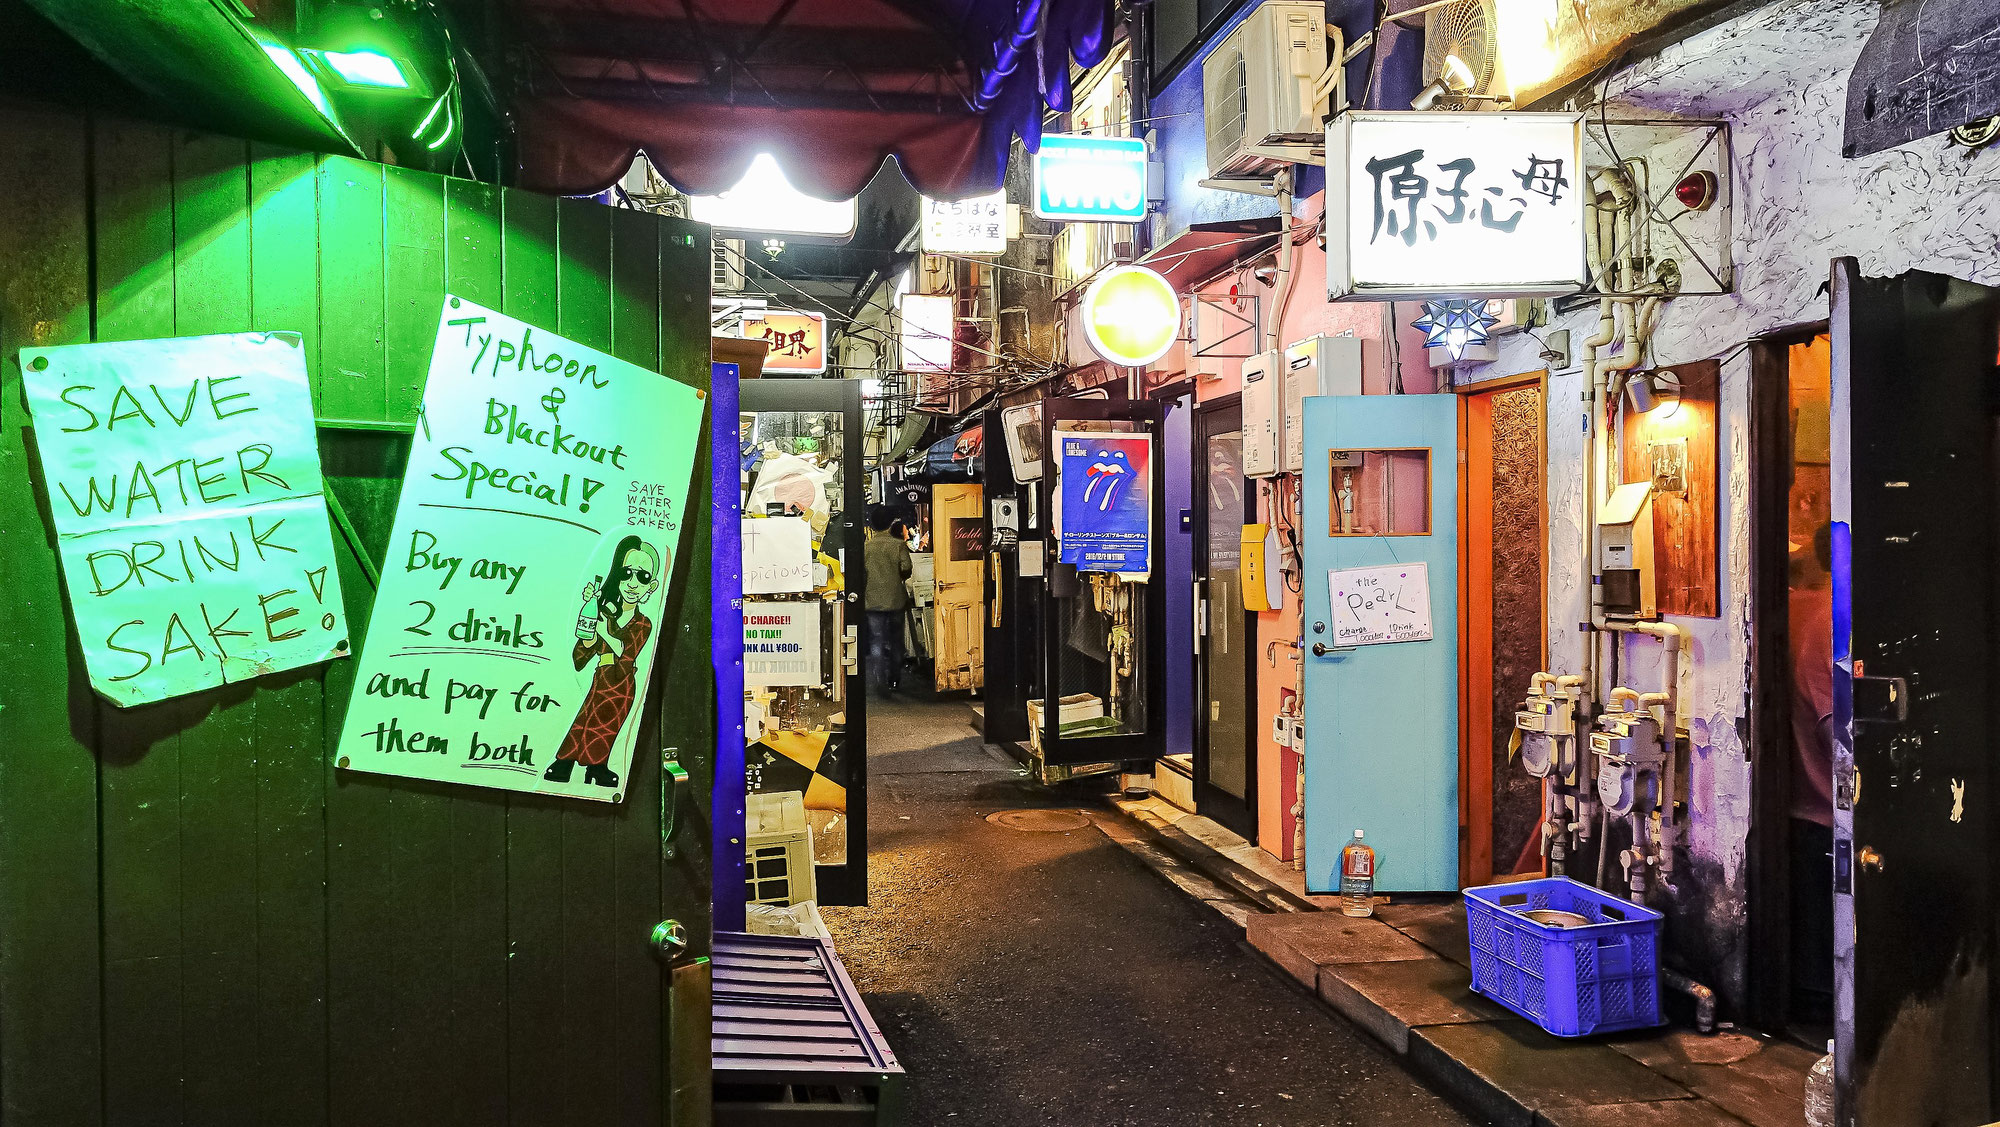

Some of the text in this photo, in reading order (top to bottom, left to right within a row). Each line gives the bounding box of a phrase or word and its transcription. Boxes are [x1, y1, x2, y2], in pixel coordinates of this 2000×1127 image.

[1365, 149, 1569, 247] 原子心母
[448, 317, 609, 389] Typhoon
[60, 376, 259, 433] SAVE
[541, 387, 566, 423] &
[484, 397, 628, 471] Blackout
[59, 443, 291, 518] WATER
[431, 447, 604, 513] Special!
[627, 494, 671, 509] WATER
[629, 481, 665, 496] SAVE
[628, 505, 670, 520] DRINK
[86, 516, 298, 596] DRINK
[405, 529, 526, 594] Buy any
[1356, 577, 1377, 587] the
[106, 566, 335, 681] SAKE!
[404, 600, 544, 648] 2 drinks
[746, 629, 782, 639] NO TAX!!
[751, 616, 791, 625] CHARGE!!
[760, 643, 775, 653] ALL
[776, 643, 802, 653] ¥800-
[366, 668, 561, 720] and pay for
[361, 717, 536, 766] them both
